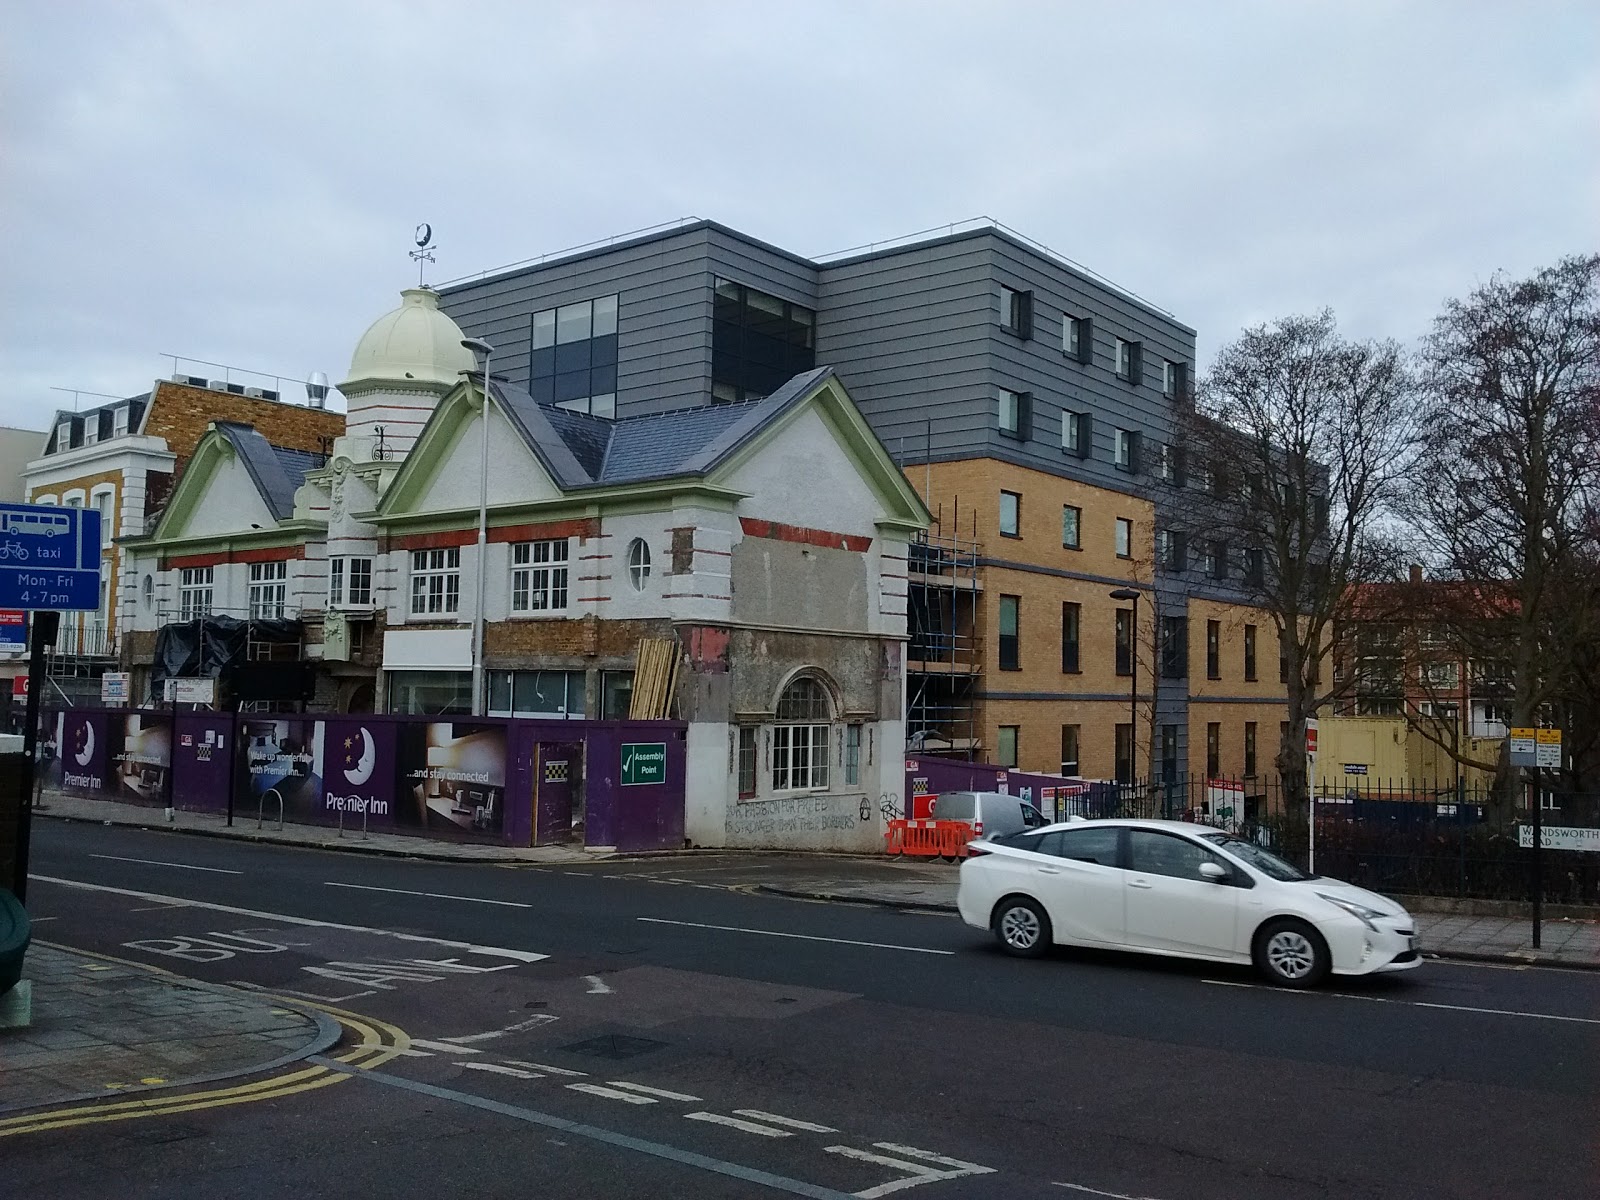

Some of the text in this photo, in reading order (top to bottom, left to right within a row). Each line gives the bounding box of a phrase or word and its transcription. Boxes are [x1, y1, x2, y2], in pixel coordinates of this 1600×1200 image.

[37, 546, 61, 559] taxi
[18, 574, 46, 586] Mon
[57, 575, 74, 587] Fri
[250, 751, 266, 761] Wake
[267, 753, 275, 763] up
[634, 752, 664, 762] Assembly
[250, 765, 263, 774] with
[263, 765, 288, 776] Premier
[641, 765, 657, 774] Point
[64, 771, 102, 789] Premier Inn
[429, 770, 446, 782] stay
[446, 770, 489, 783] connected
[326, 792, 388, 815] Premier Inn
[1522, 827, 1599, 839] WNDSWORTH
[119, 927, 312, 963] BUS
